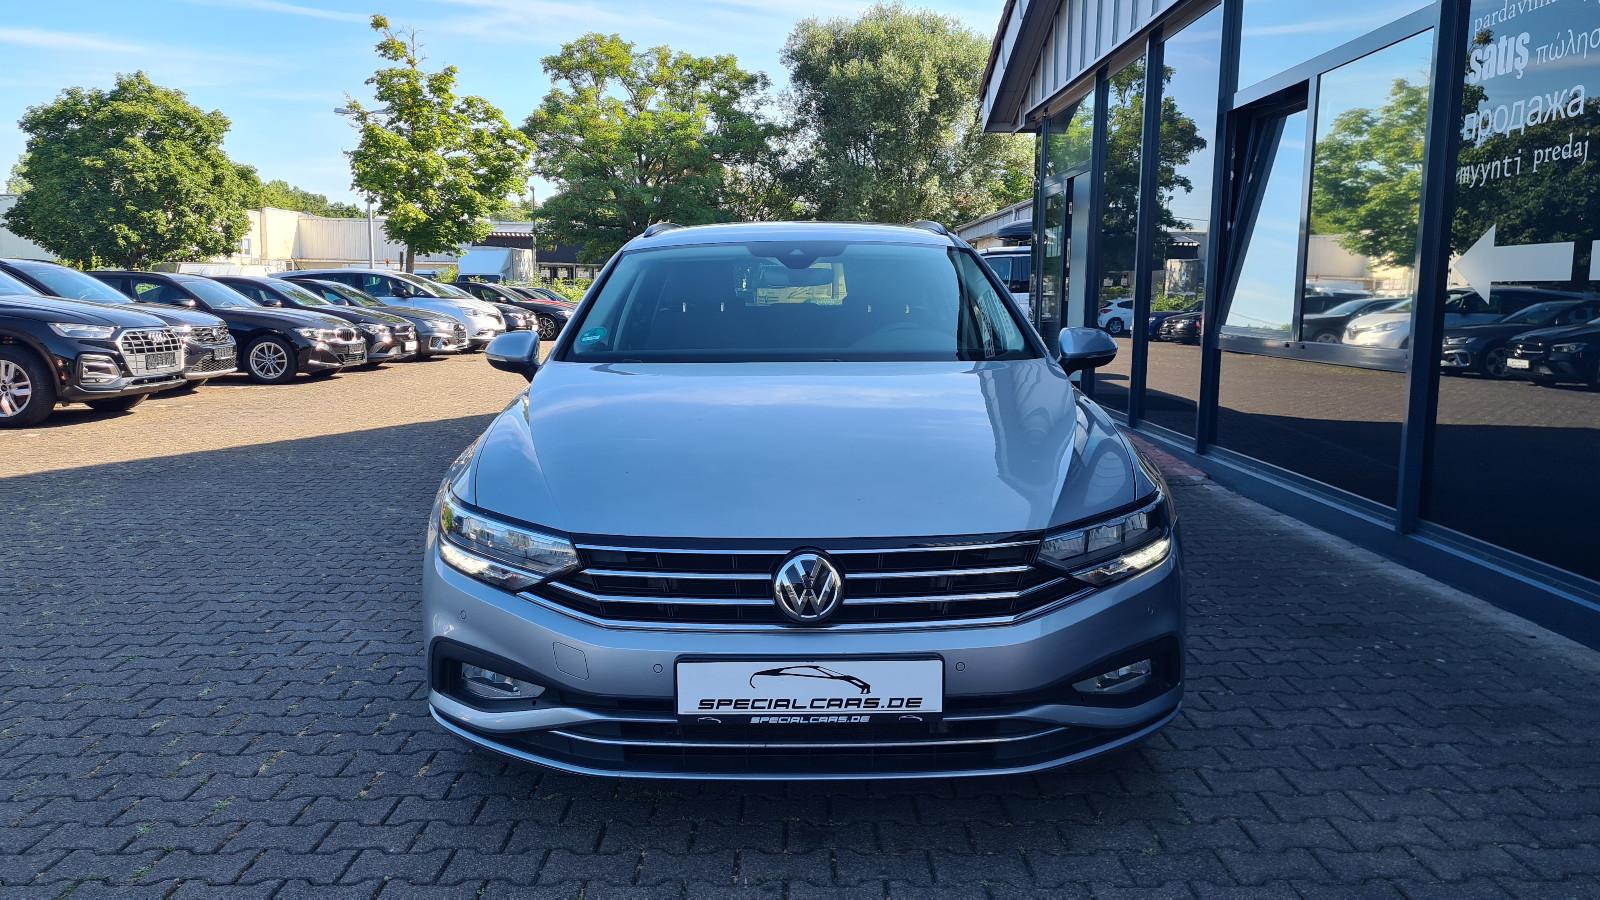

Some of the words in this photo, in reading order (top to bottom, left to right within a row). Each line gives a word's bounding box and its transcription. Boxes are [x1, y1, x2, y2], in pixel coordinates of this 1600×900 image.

[1474, 0, 1558, 40] pardavi
[1467, 32, 1530, 84] satış
[1463, 84, 1585, 149] продажа
[1456, 148, 1521, 189] myynti
[1532, 131, 1590, 173] predaj
[698, 697, 922, 710] SPECIALCARS.DE
[750, 715, 870, 725] SPECIALCARS.DE
